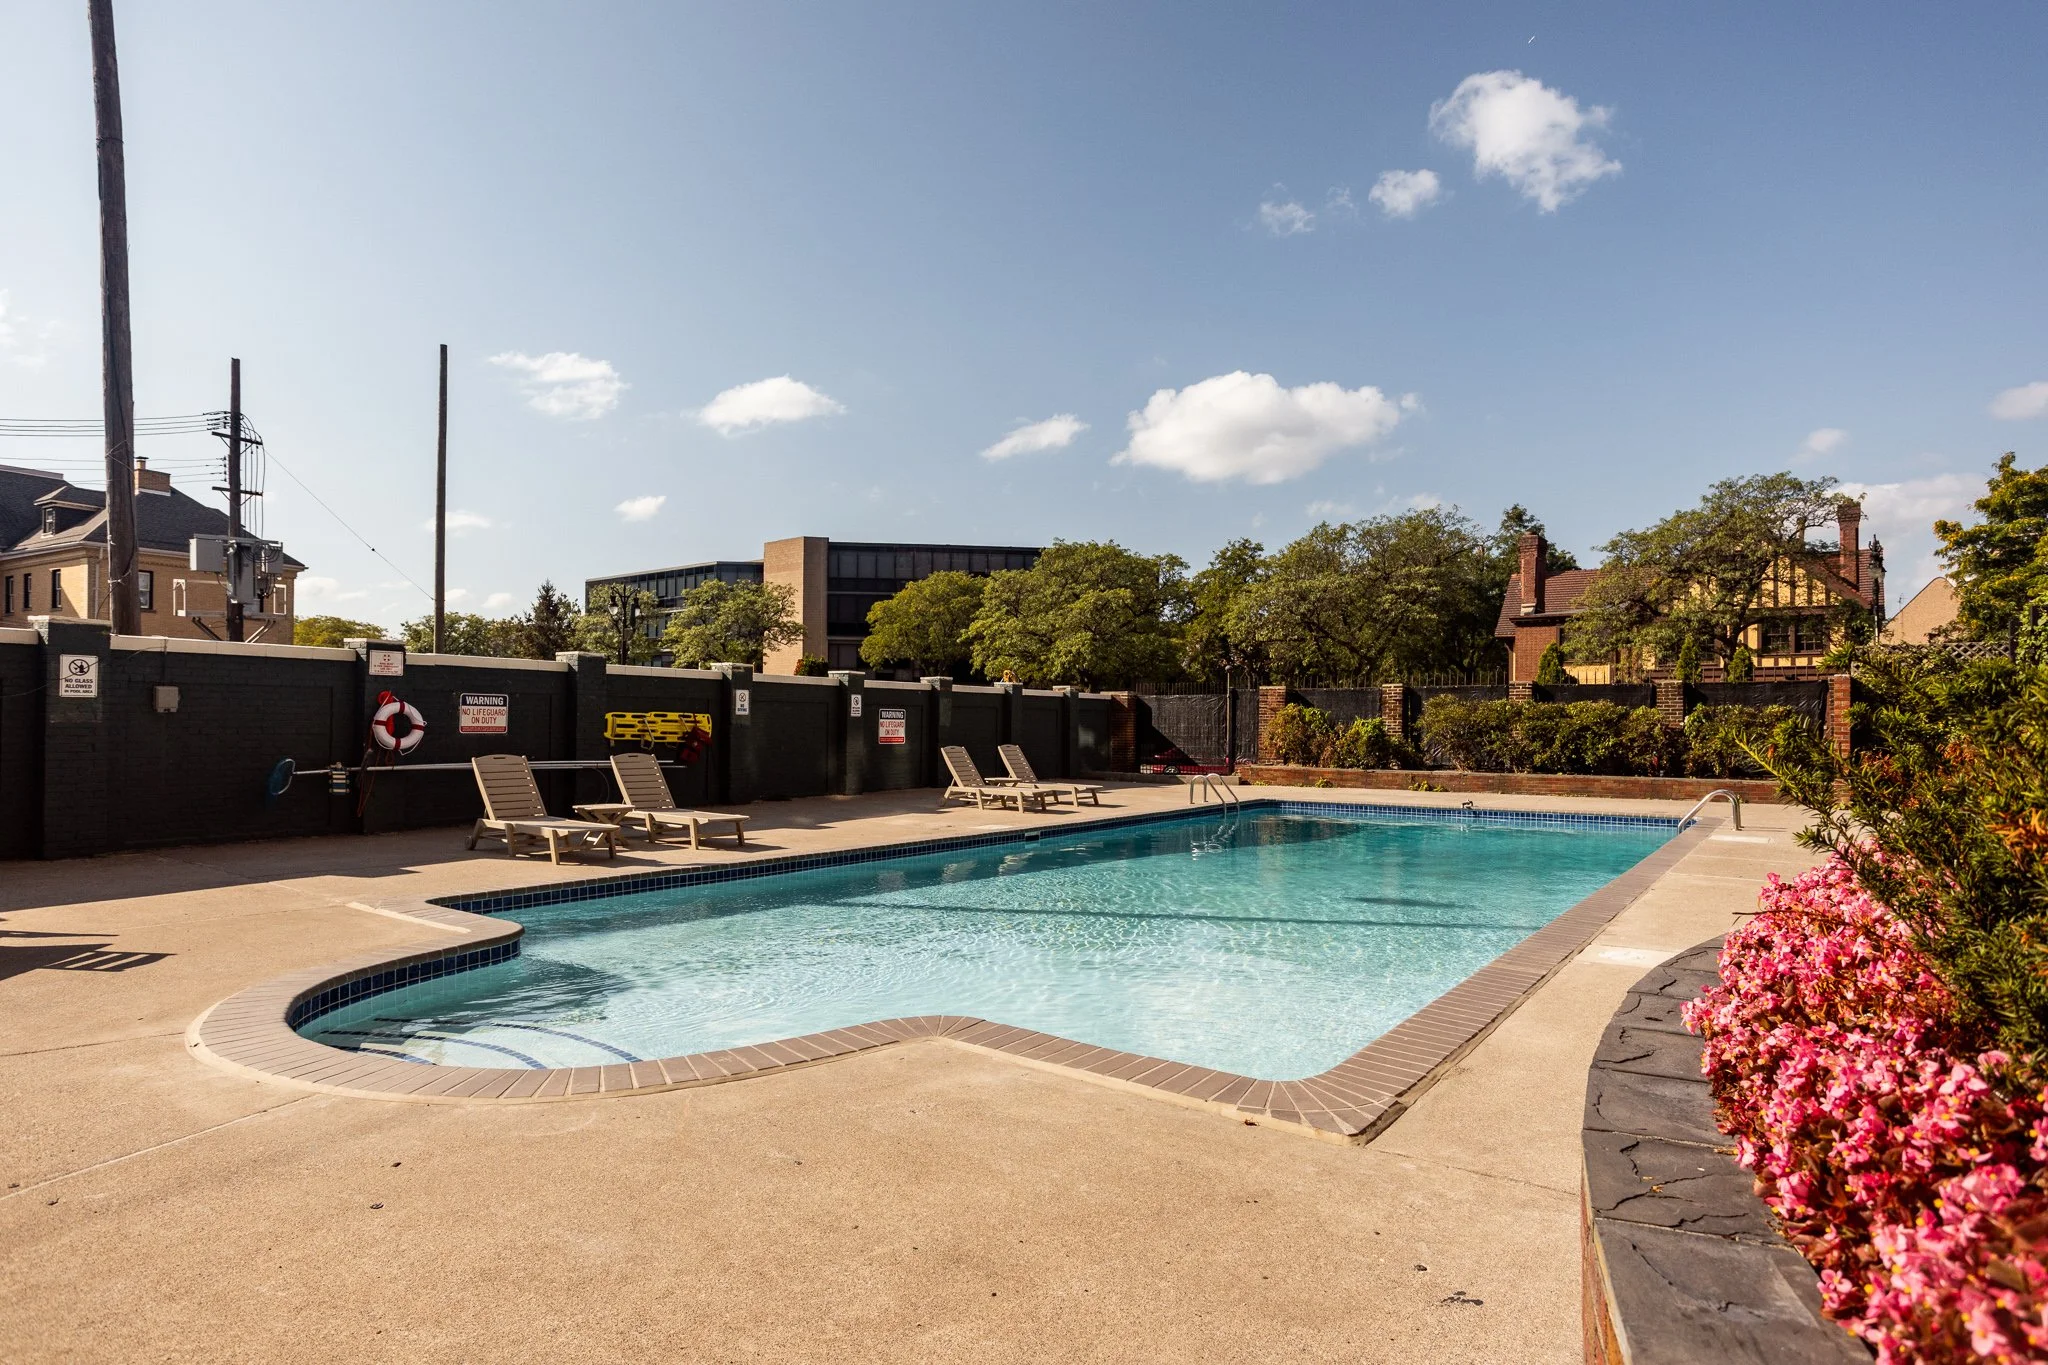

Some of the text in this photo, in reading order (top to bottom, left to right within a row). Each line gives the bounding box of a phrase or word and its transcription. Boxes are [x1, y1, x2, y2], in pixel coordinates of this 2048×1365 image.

[465, 696, 504, 705] WARNING
[462, 708, 506, 716] NO LIFEGUARD
[881, 711, 904, 719] WARNING
